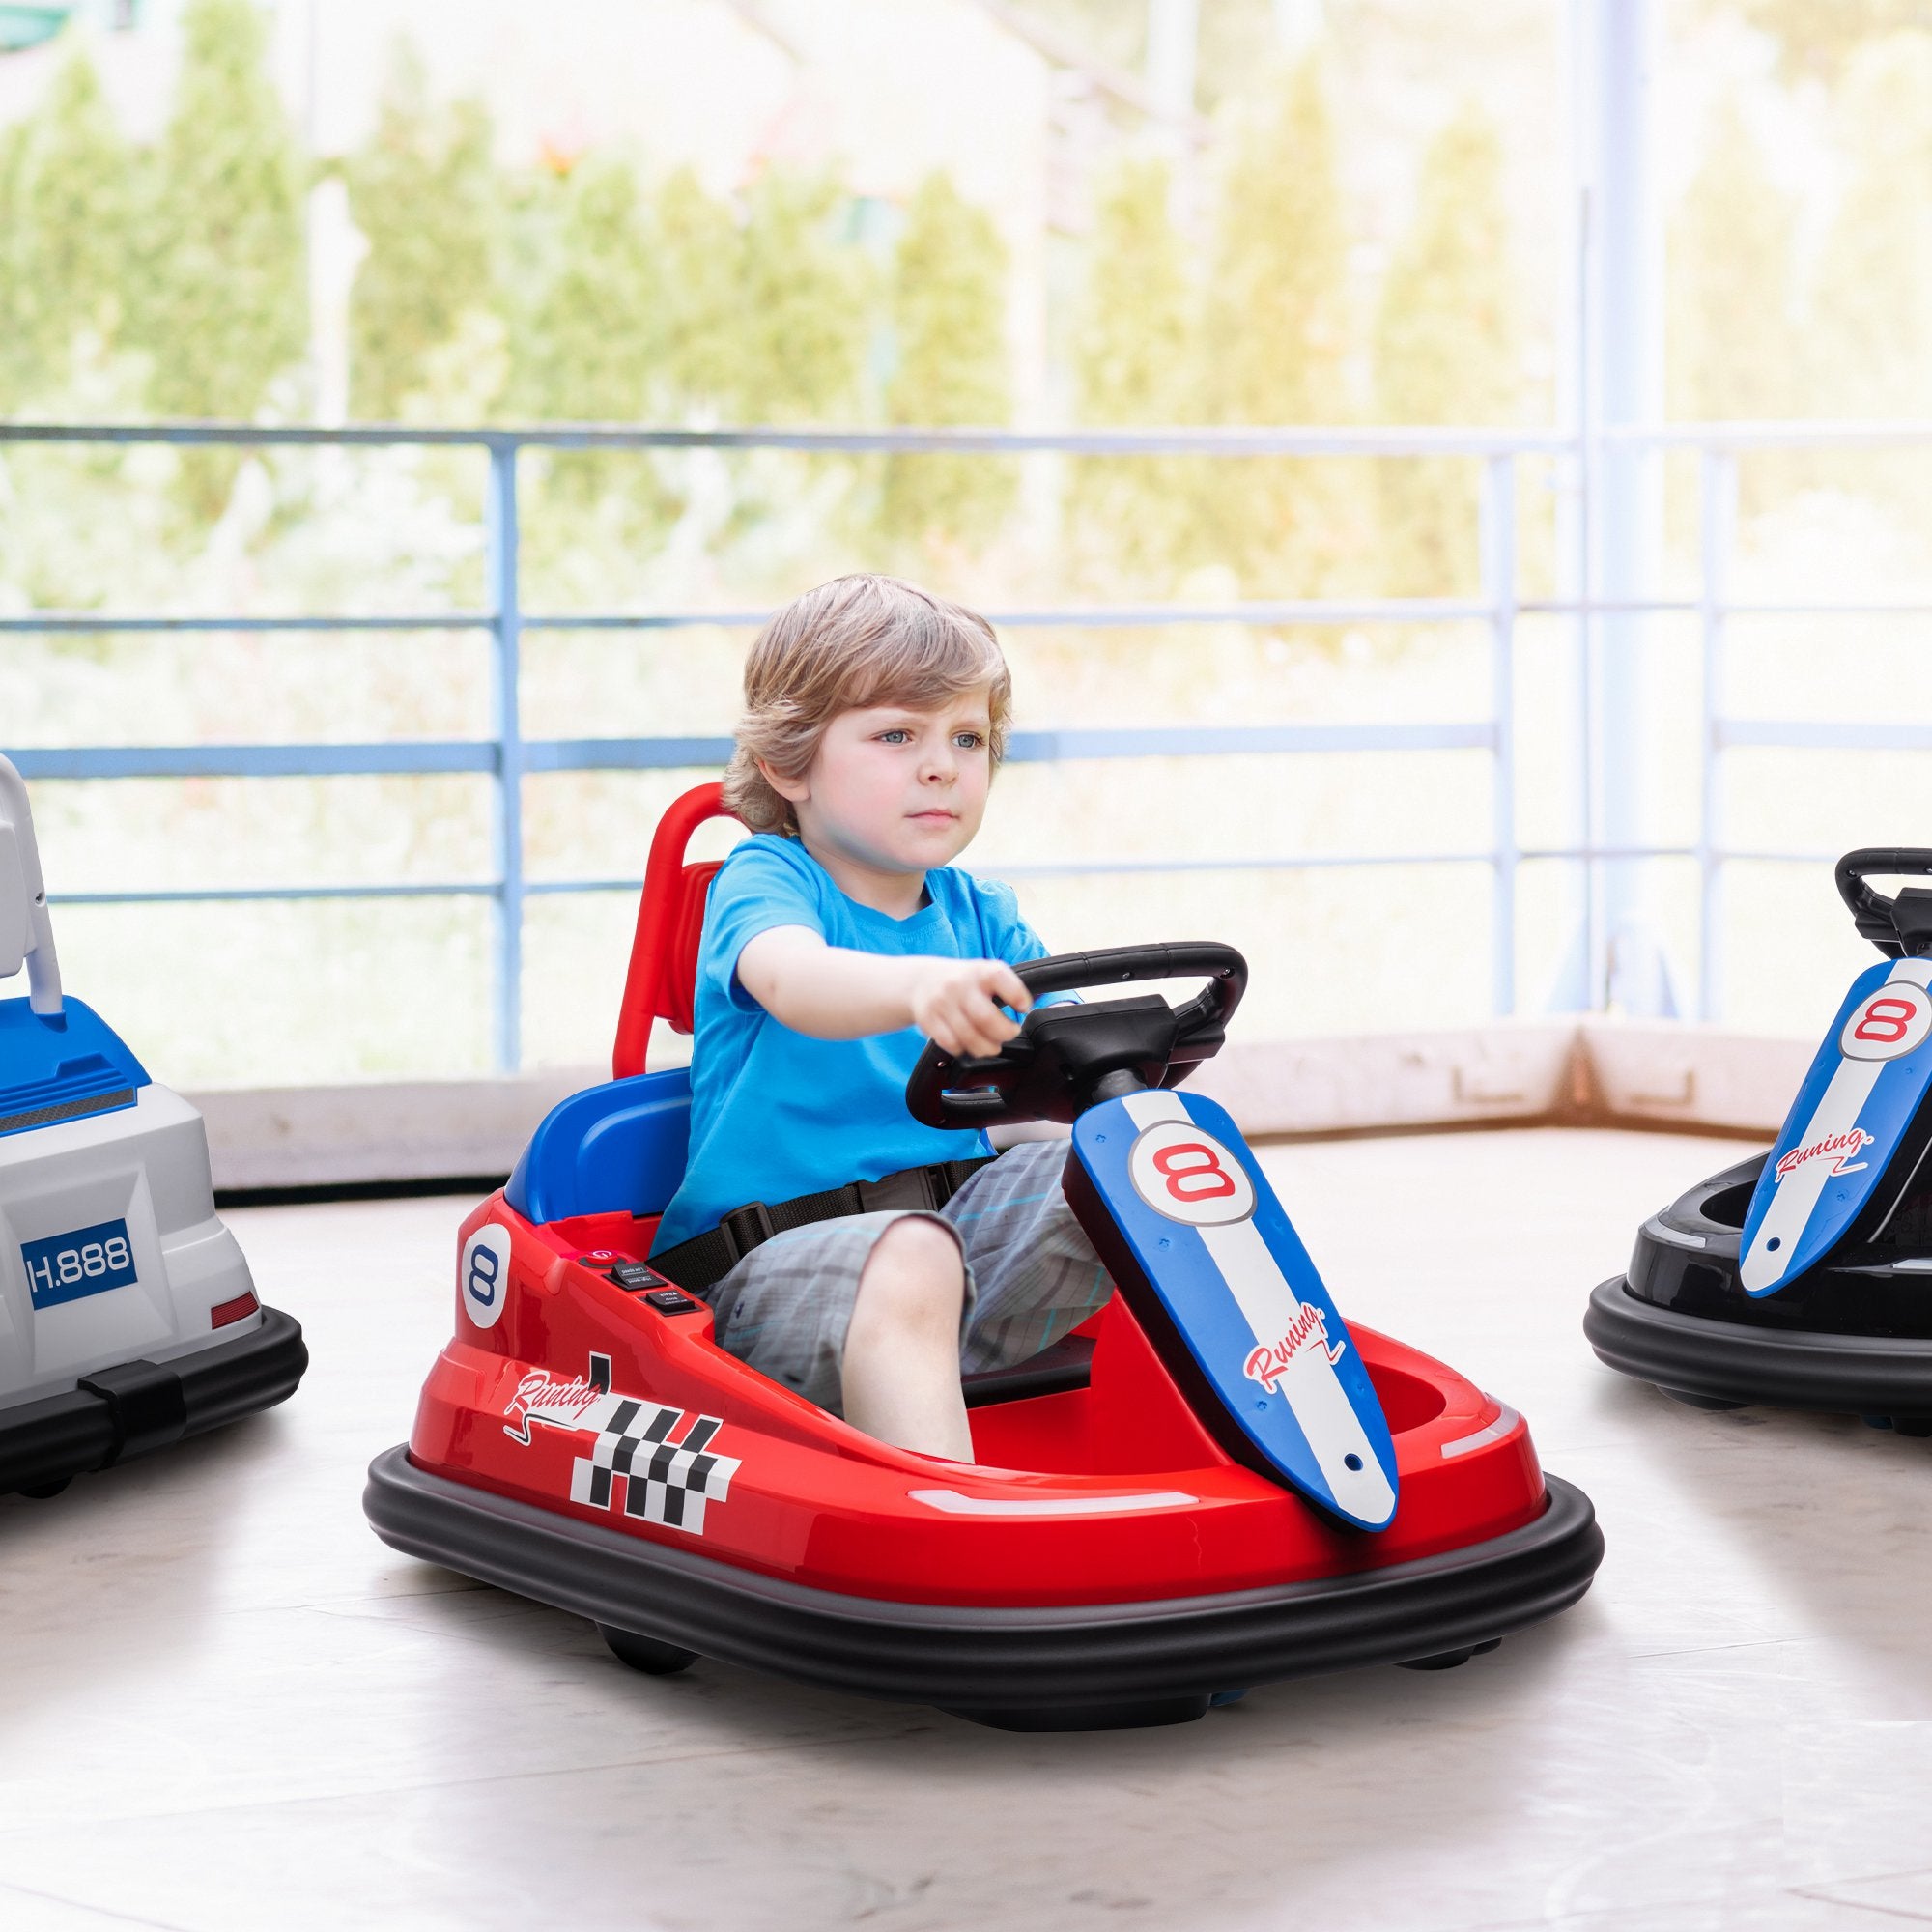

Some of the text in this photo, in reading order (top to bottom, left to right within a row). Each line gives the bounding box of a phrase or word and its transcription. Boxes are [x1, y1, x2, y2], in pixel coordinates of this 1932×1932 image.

[1854, 998, 1918, 1043] 8
[1152, 1143, 1236, 1202] 8
[26, 1236, 130, 1293] H.888
[469, 1244, 499, 1307] 8
